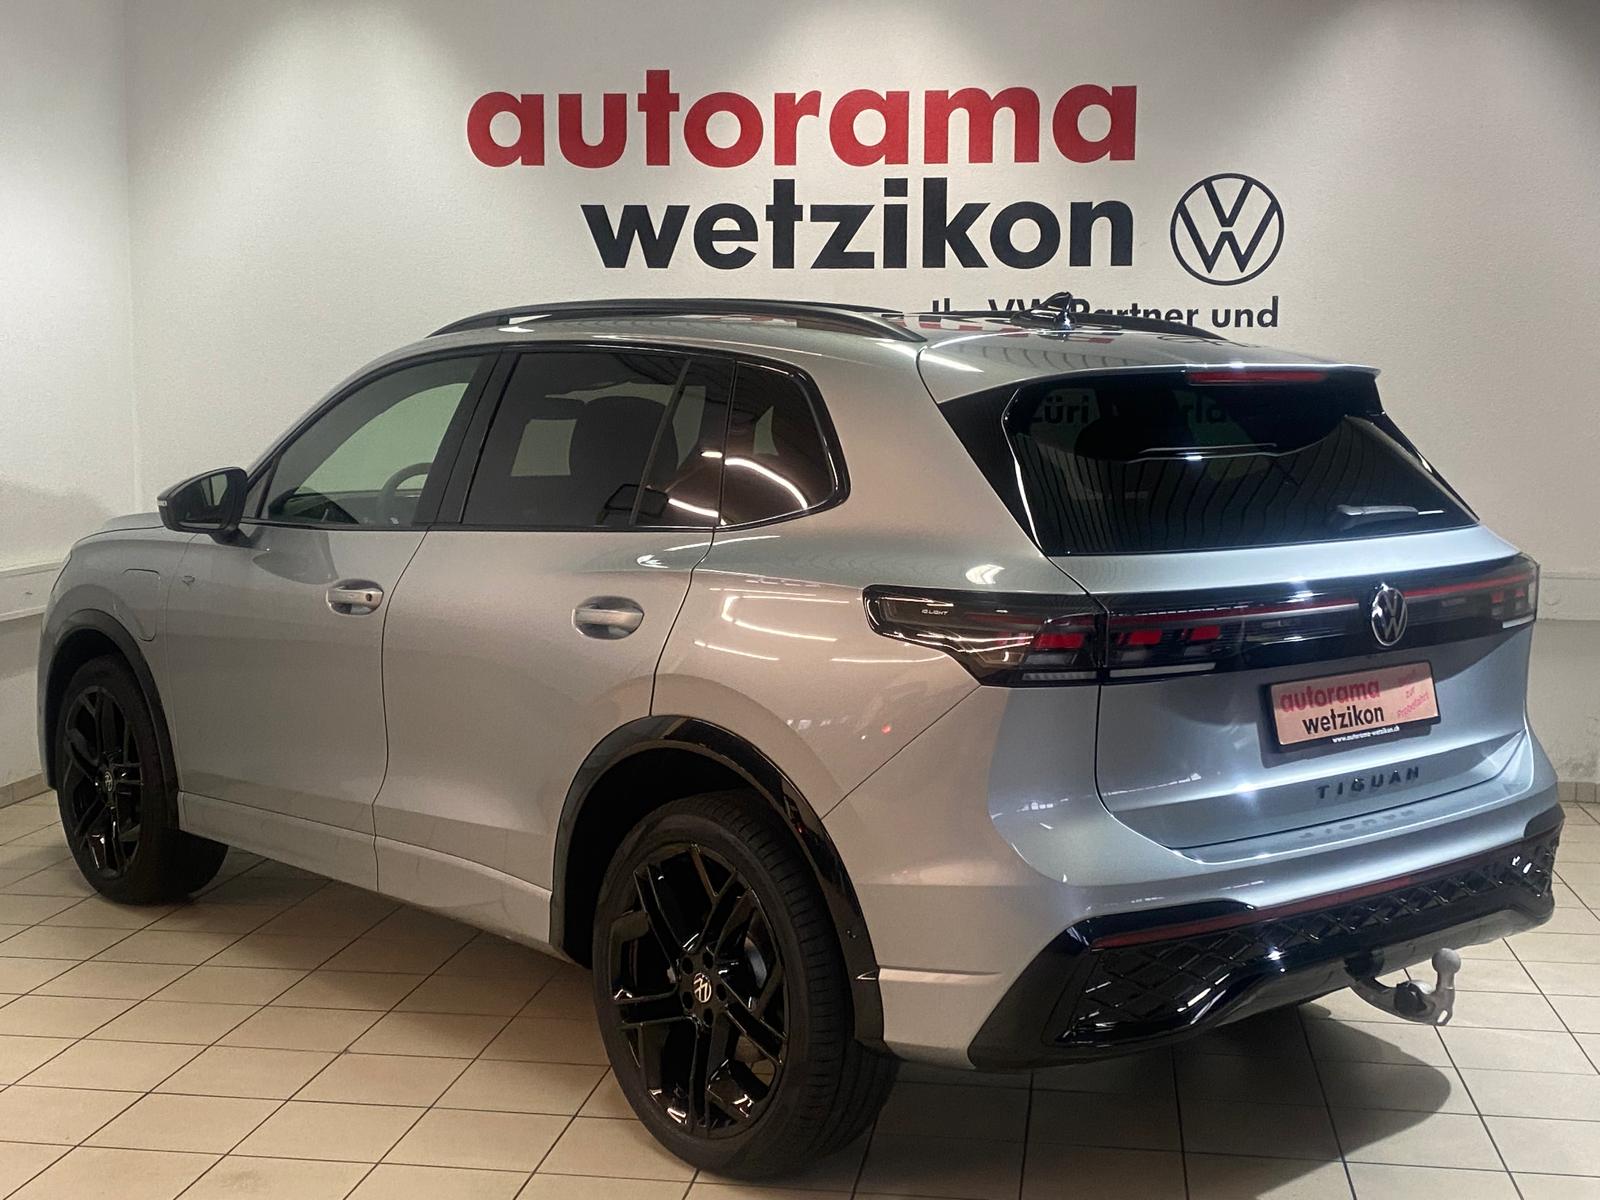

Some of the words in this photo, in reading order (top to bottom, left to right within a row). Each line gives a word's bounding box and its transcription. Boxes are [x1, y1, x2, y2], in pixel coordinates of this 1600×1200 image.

[467, 71, 1136, 169] autorama
[581, 176, 1134, 270] wetzikon
[1070, 298, 1199, 327] Ptner
[1211, 295, 1279, 328] und
[1034, 394, 1090, 423] üri
[1280, 680, 1381, 712] autorama
[1301, 704, 1385, 735] wetzikon
[1317, 766, 1419, 798] TIGUAN
